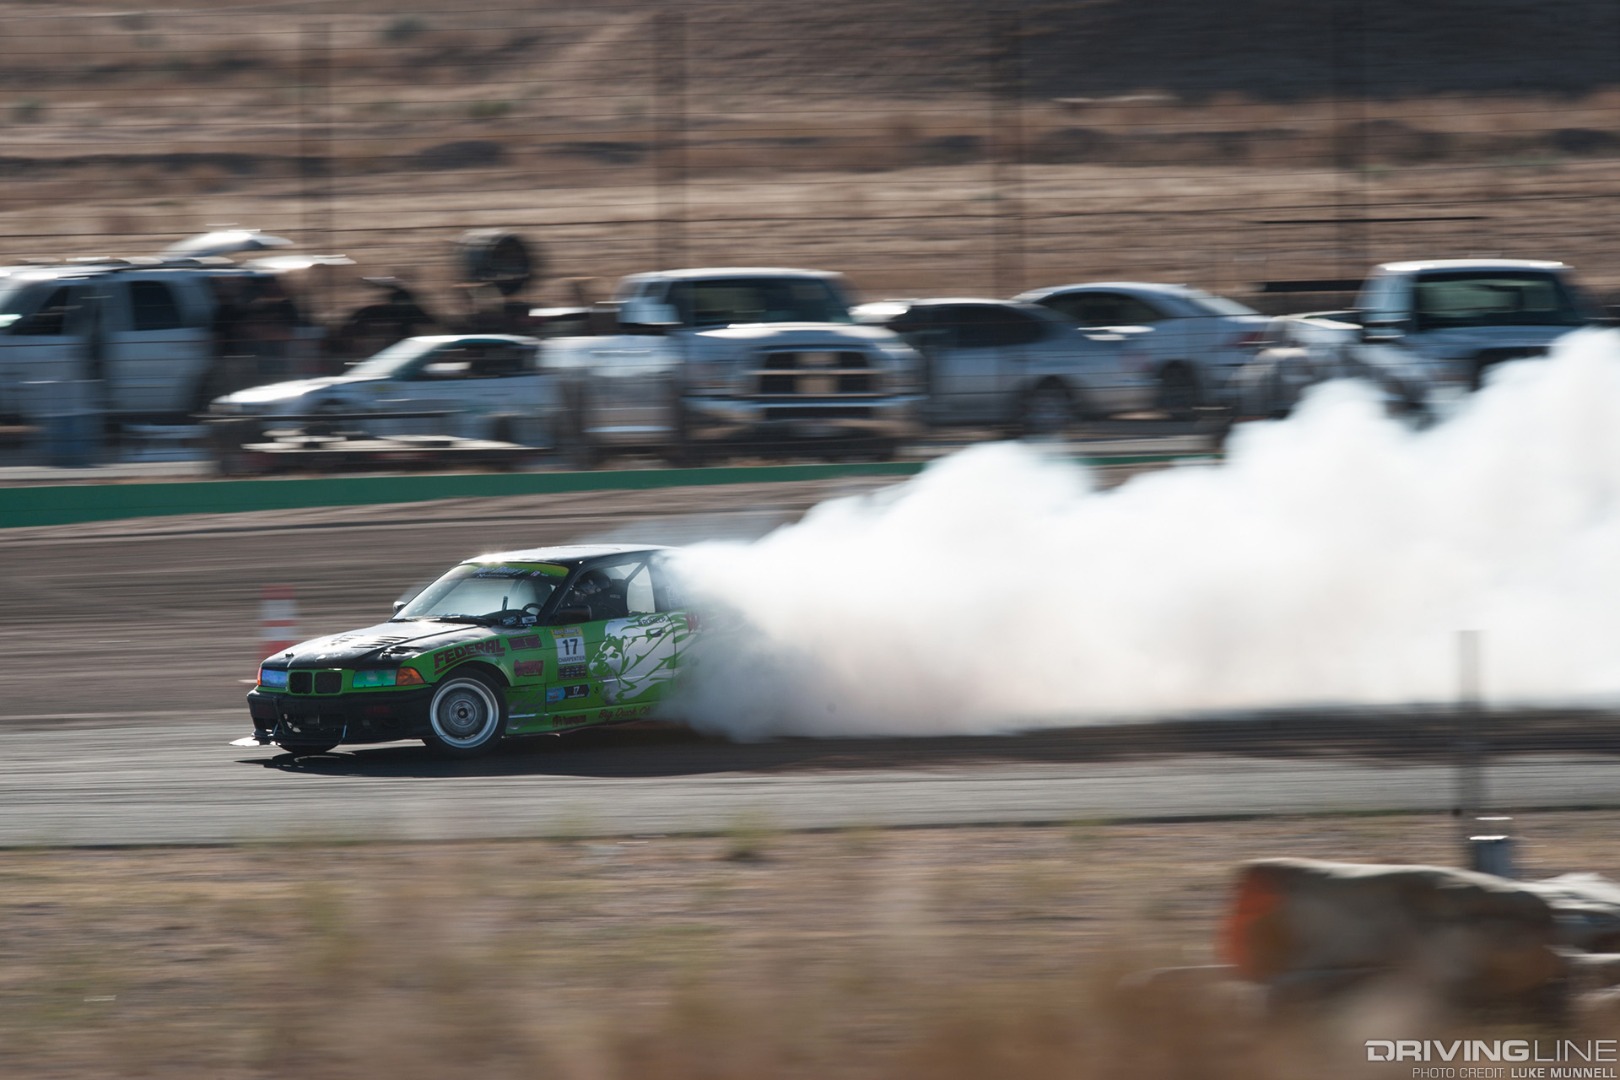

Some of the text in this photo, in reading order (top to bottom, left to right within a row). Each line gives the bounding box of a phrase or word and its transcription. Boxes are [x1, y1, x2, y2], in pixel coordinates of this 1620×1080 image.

[433, 639, 505, 669] FEDERAL
[562, 638, 578, 655] 17
[573, 686, 580, 694] 17
